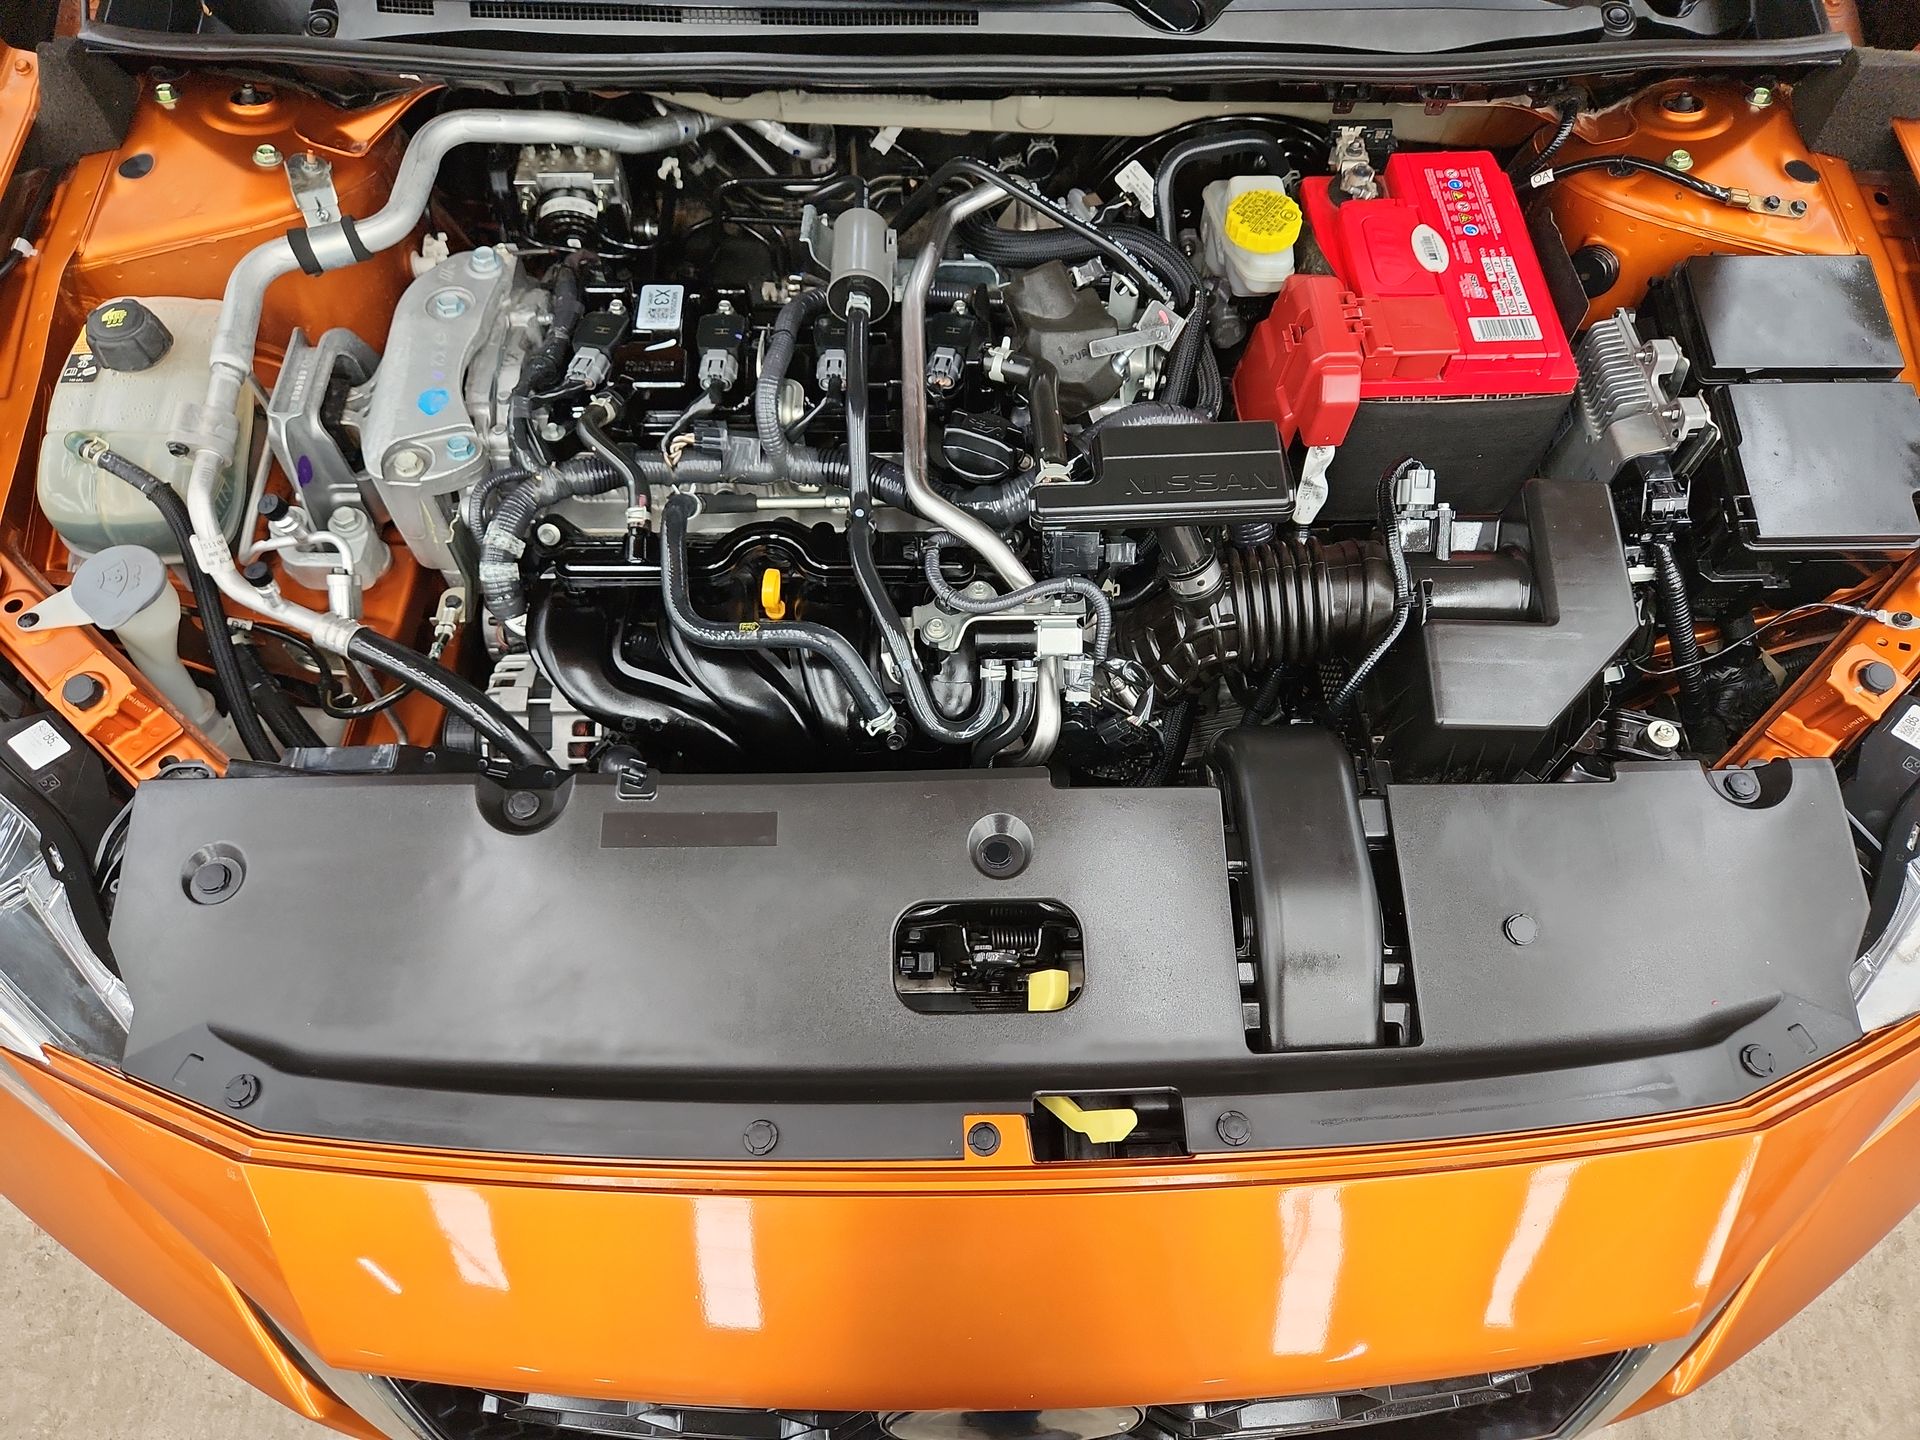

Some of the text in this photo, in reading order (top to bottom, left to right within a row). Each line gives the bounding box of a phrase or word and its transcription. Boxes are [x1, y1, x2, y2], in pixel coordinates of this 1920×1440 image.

[653, 288, 672, 306] X3
[1517, 300, 1531, 315] 12V
[1124, 471, 1279, 496] NISSAN
